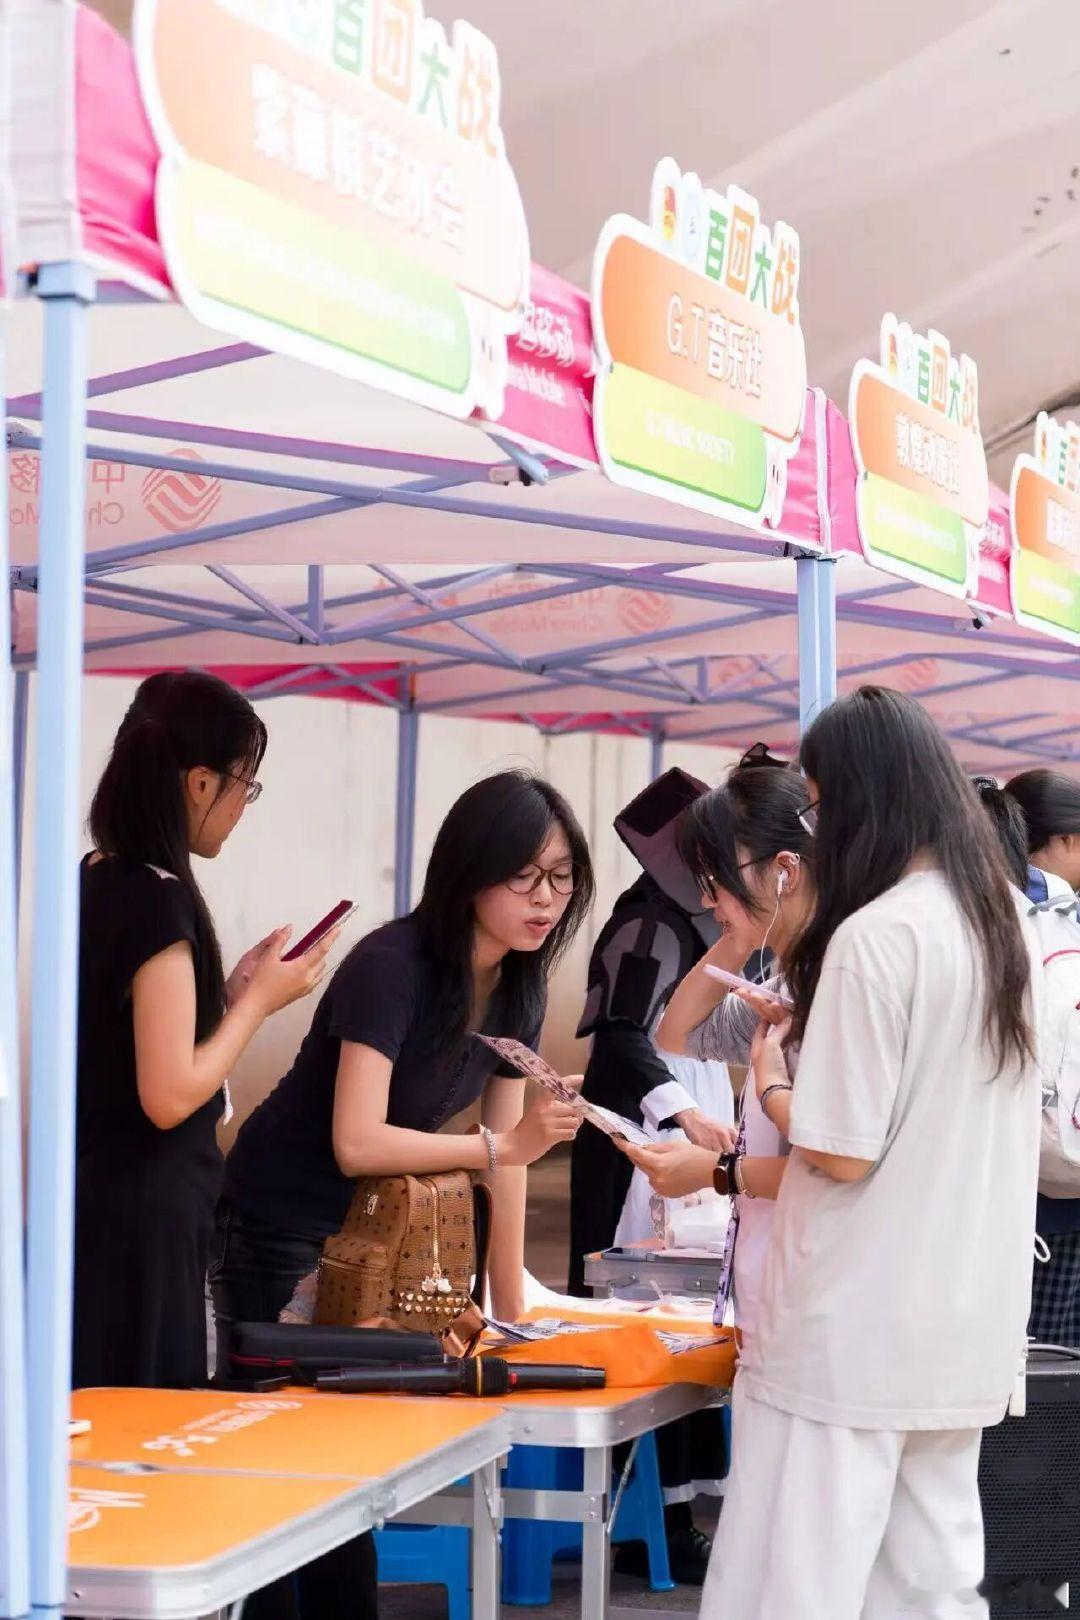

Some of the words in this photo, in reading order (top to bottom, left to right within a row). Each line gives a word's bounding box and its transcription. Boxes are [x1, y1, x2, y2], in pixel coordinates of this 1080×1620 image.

[333, 0, 498, 158] 百团大战
[705, 204, 796, 325] 百团大战
